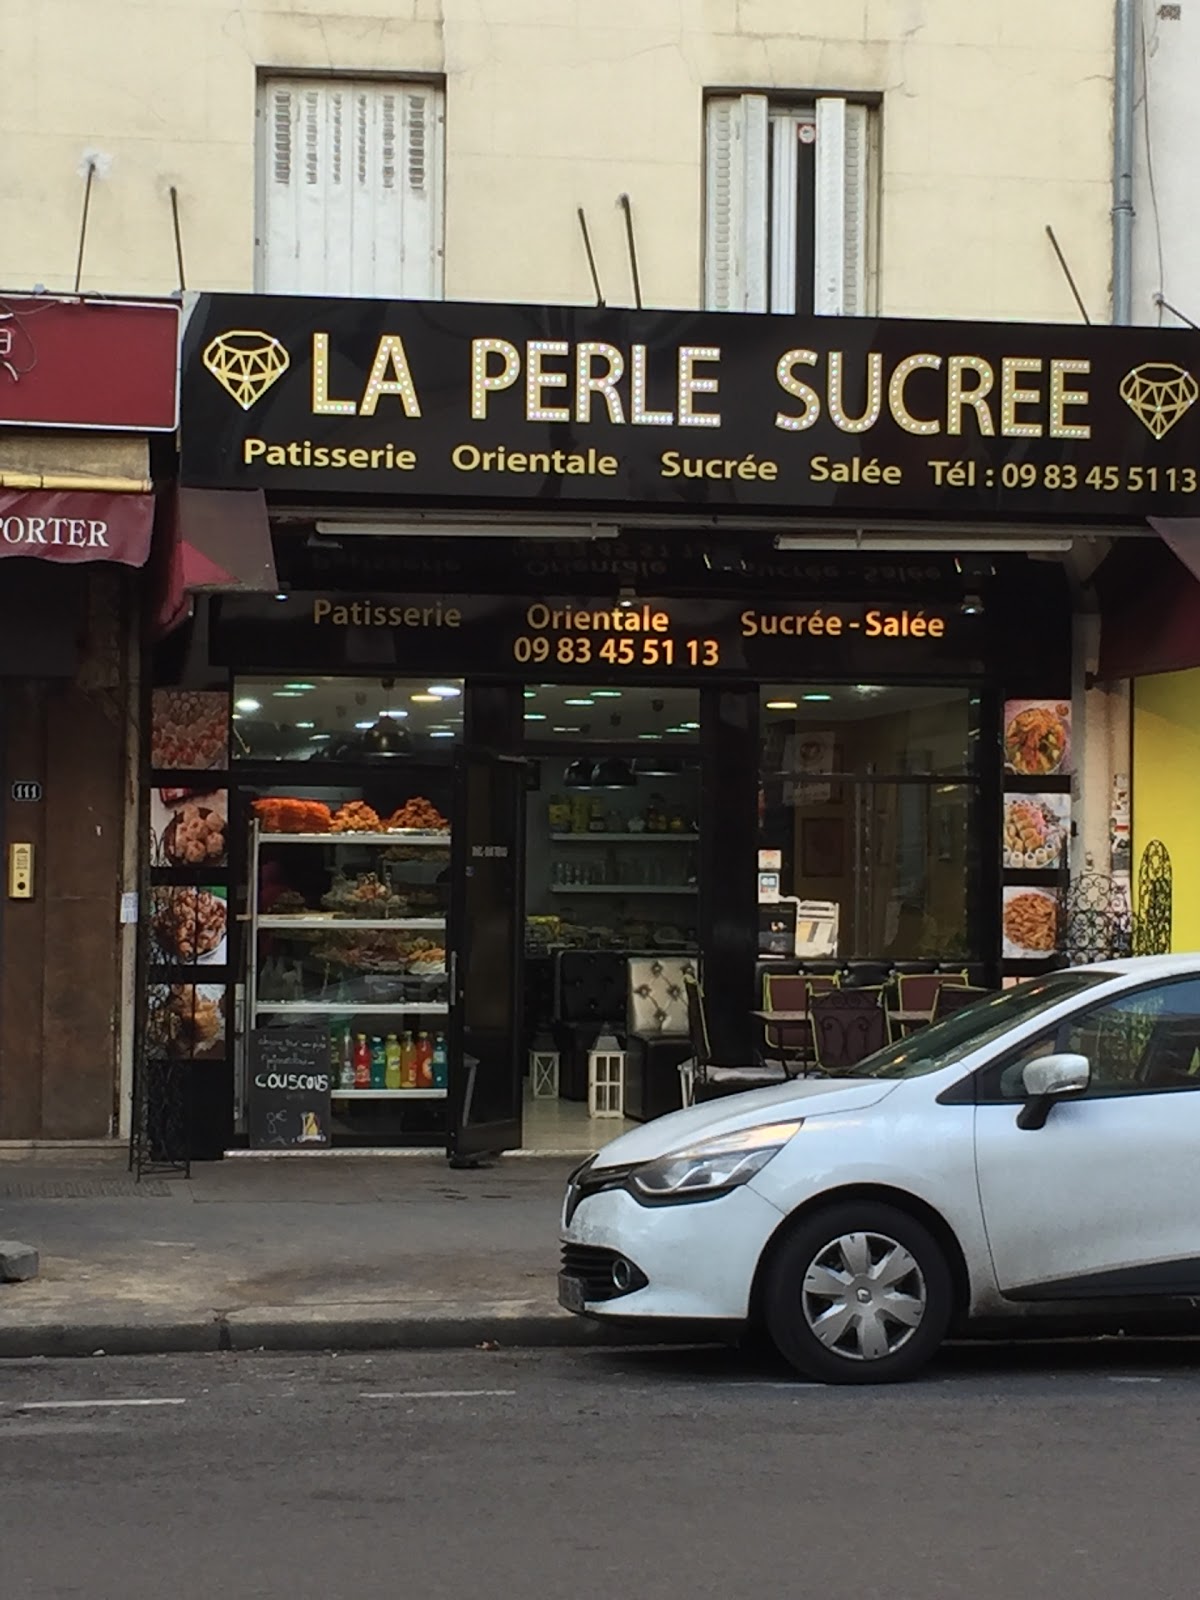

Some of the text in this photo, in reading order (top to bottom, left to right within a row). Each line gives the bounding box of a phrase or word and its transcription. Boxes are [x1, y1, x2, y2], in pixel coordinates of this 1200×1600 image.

[312, 332, 1092, 440] LA PERLE SUCREE
[243, 438, 418, 471] Patisserie
[451, 444, 619, 476] Orientale
[660, 451, 779, 482] Sucrée
[809, 456, 903, 486] Salée
[927, 460, 976, 488] Tél
[1002, 462, 1037, 489] 09
[1043, 464, 1078, 491] 83
[1085, 465, 1120, 492] 45
[1127, 467, 1158, 493] 51
[1166, 467, 1199, 494] 13
[0, 516, 110, 549] ORTER
[312, 598, 463, 628] Patisserie
[526, 603, 670, 633] Orientale
[741, 608, 843, 637] Sucrée
[864, 610, 945, 639] Salée
[513, 636, 720, 667] 09 83 45 51 13
[16, 784, 38, 799] 111
